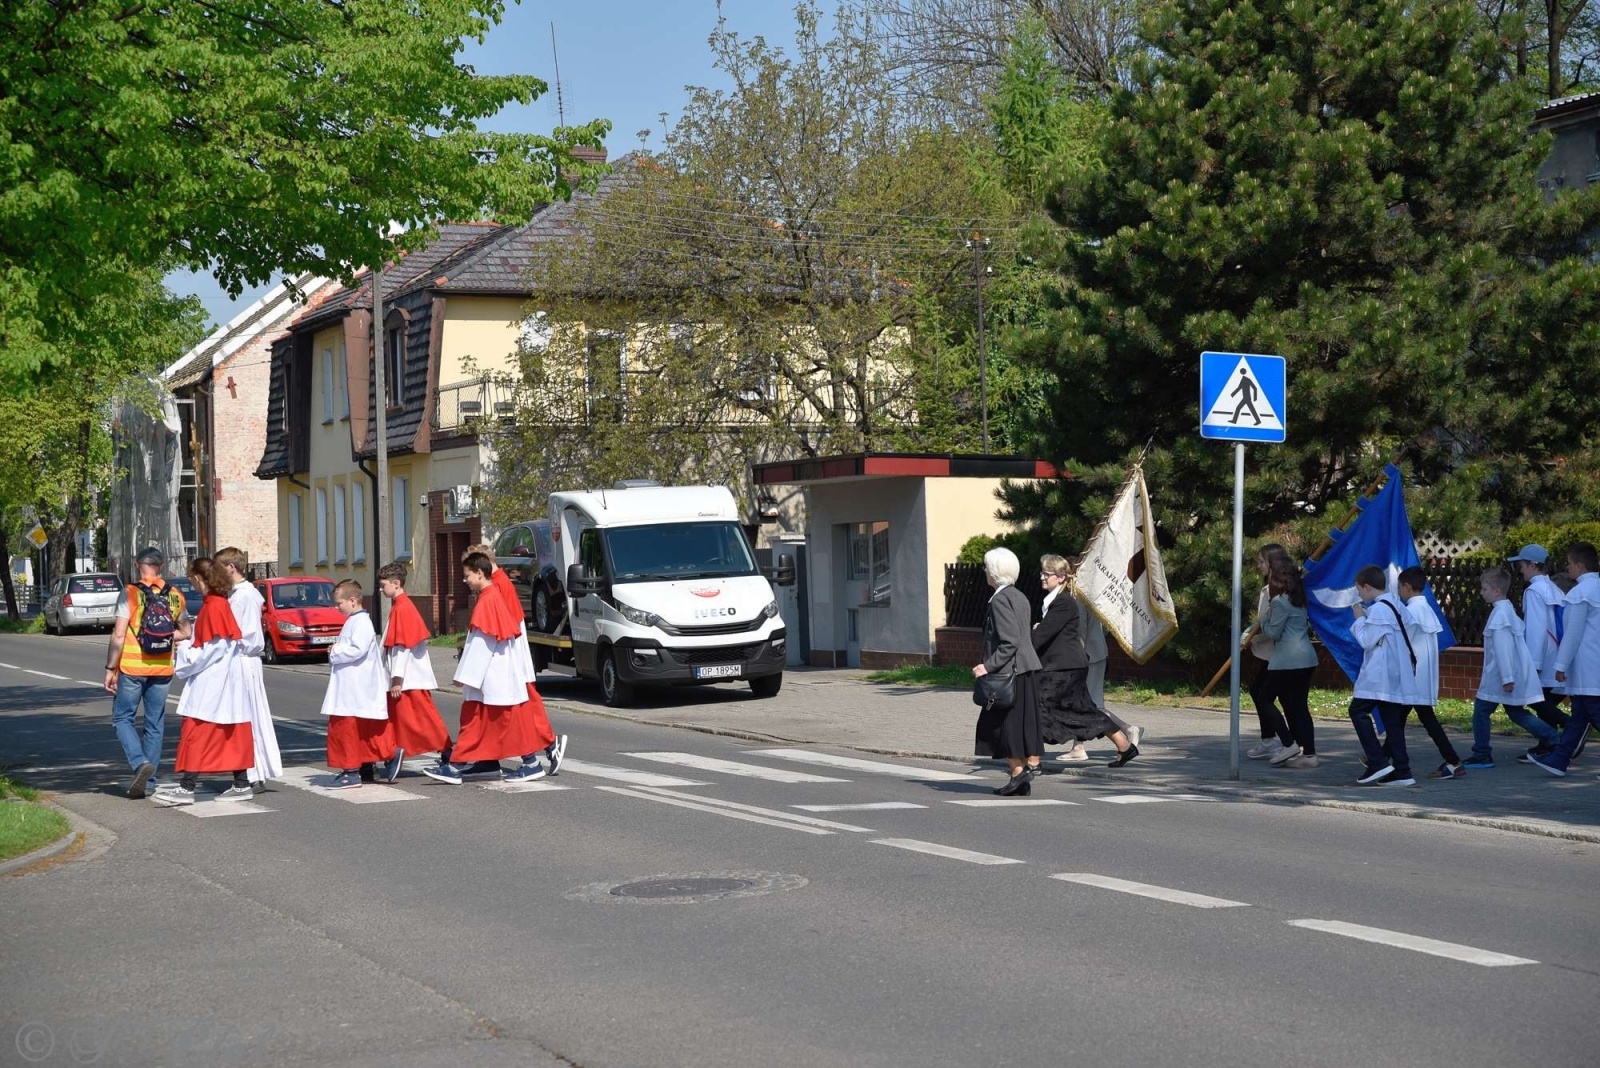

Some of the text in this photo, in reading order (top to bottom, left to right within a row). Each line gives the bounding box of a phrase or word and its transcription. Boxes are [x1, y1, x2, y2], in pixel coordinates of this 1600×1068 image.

[1094, 556, 1119, 586] PARAFIA
[694, 607, 736, 618] IVECO
[701, 667, 713, 676] OP
